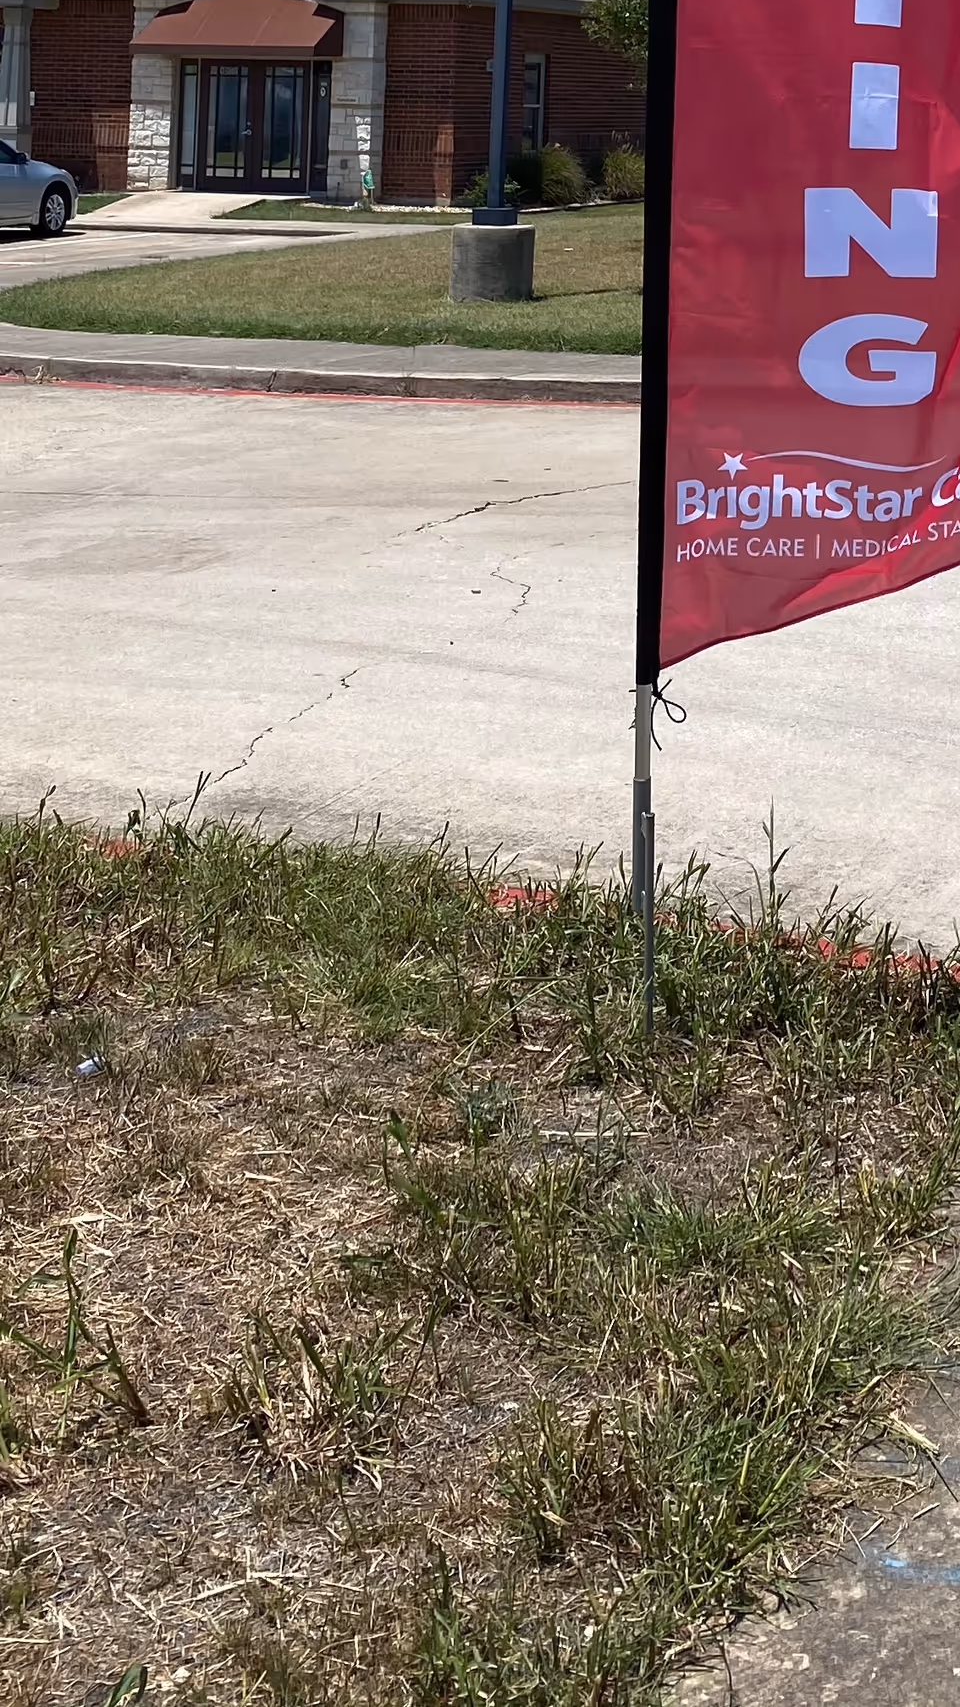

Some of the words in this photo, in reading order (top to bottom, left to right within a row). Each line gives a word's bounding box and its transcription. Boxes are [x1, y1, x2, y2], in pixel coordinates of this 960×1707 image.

[676, 474, 923, 530] BrightStar
[676, 537, 738, 562] HOME
[746, 537, 805, 557] CARE
[831, 529, 922, 558] MEDICAL
